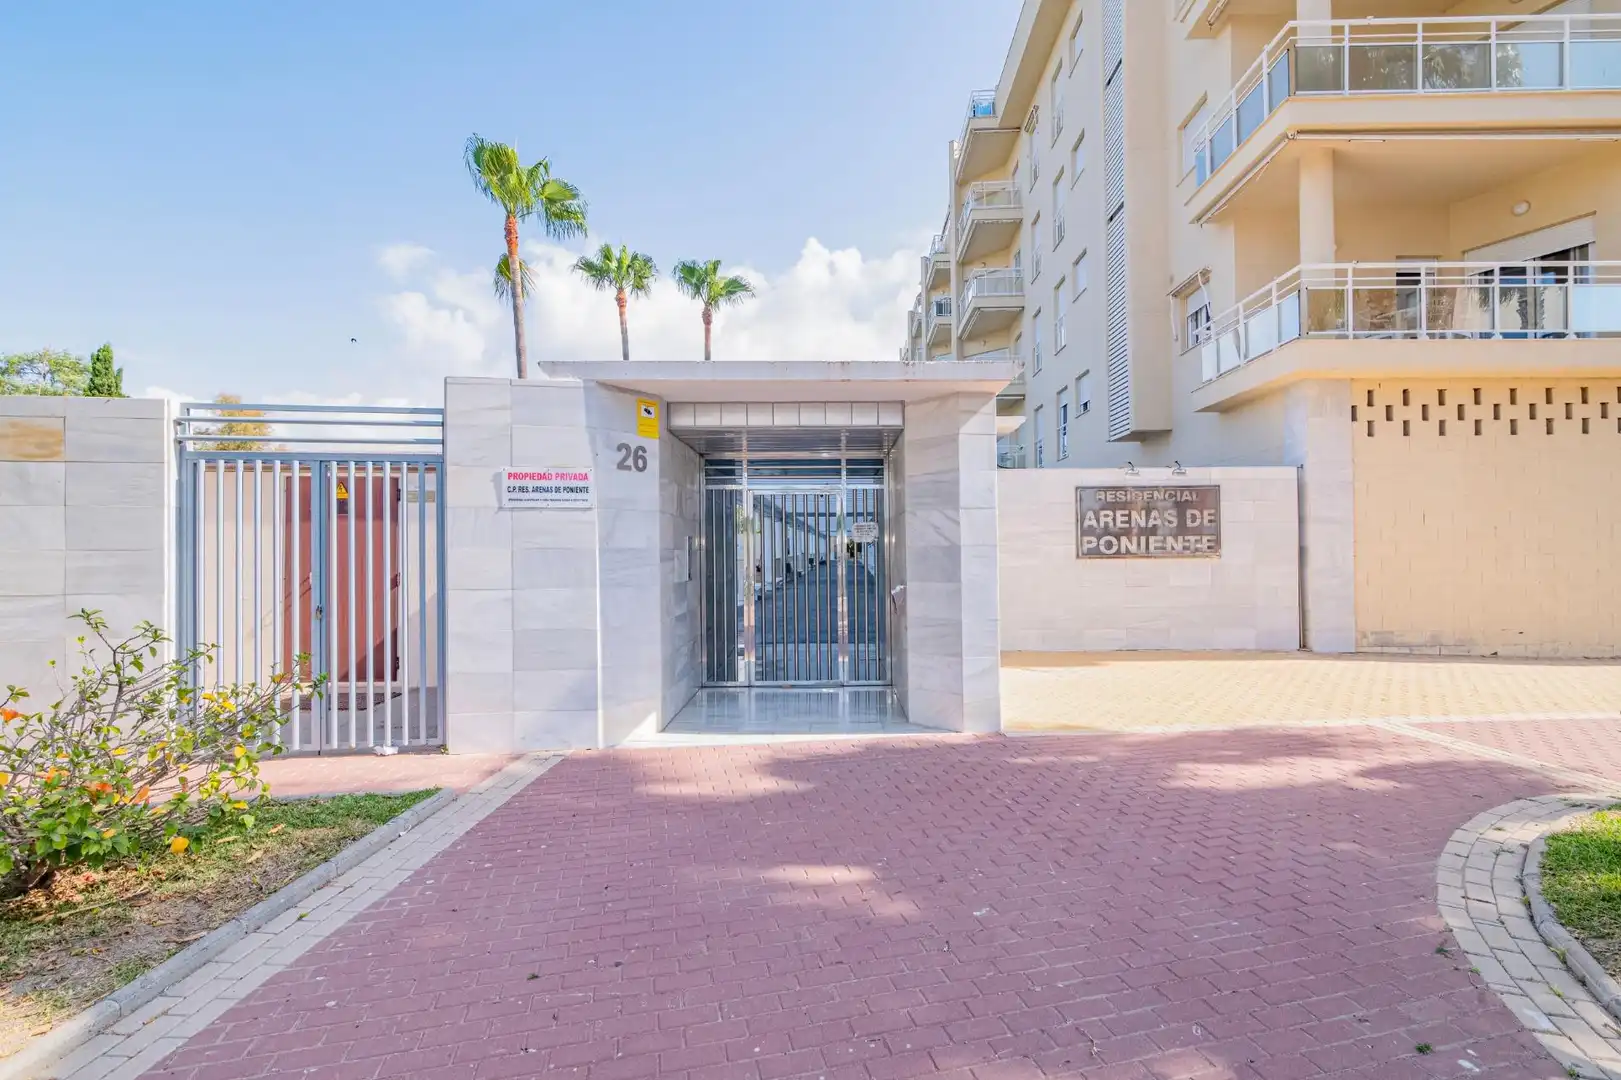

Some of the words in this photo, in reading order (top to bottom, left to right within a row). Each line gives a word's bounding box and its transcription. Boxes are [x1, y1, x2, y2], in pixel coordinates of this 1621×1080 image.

[616, 443, 648, 472] 26
[507, 472, 553, 481] PROPIEDAD
[555, 472, 589, 481] PRIVADA
[562, 486, 589, 494] PONIENTE
[1095, 490, 1199, 502] RESIDENCIAL
[1083, 510, 1178, 528] ARENAS
[1186, 509, 1216, 527] DE
[1082, 536, 1216, 554] PONIENTE
